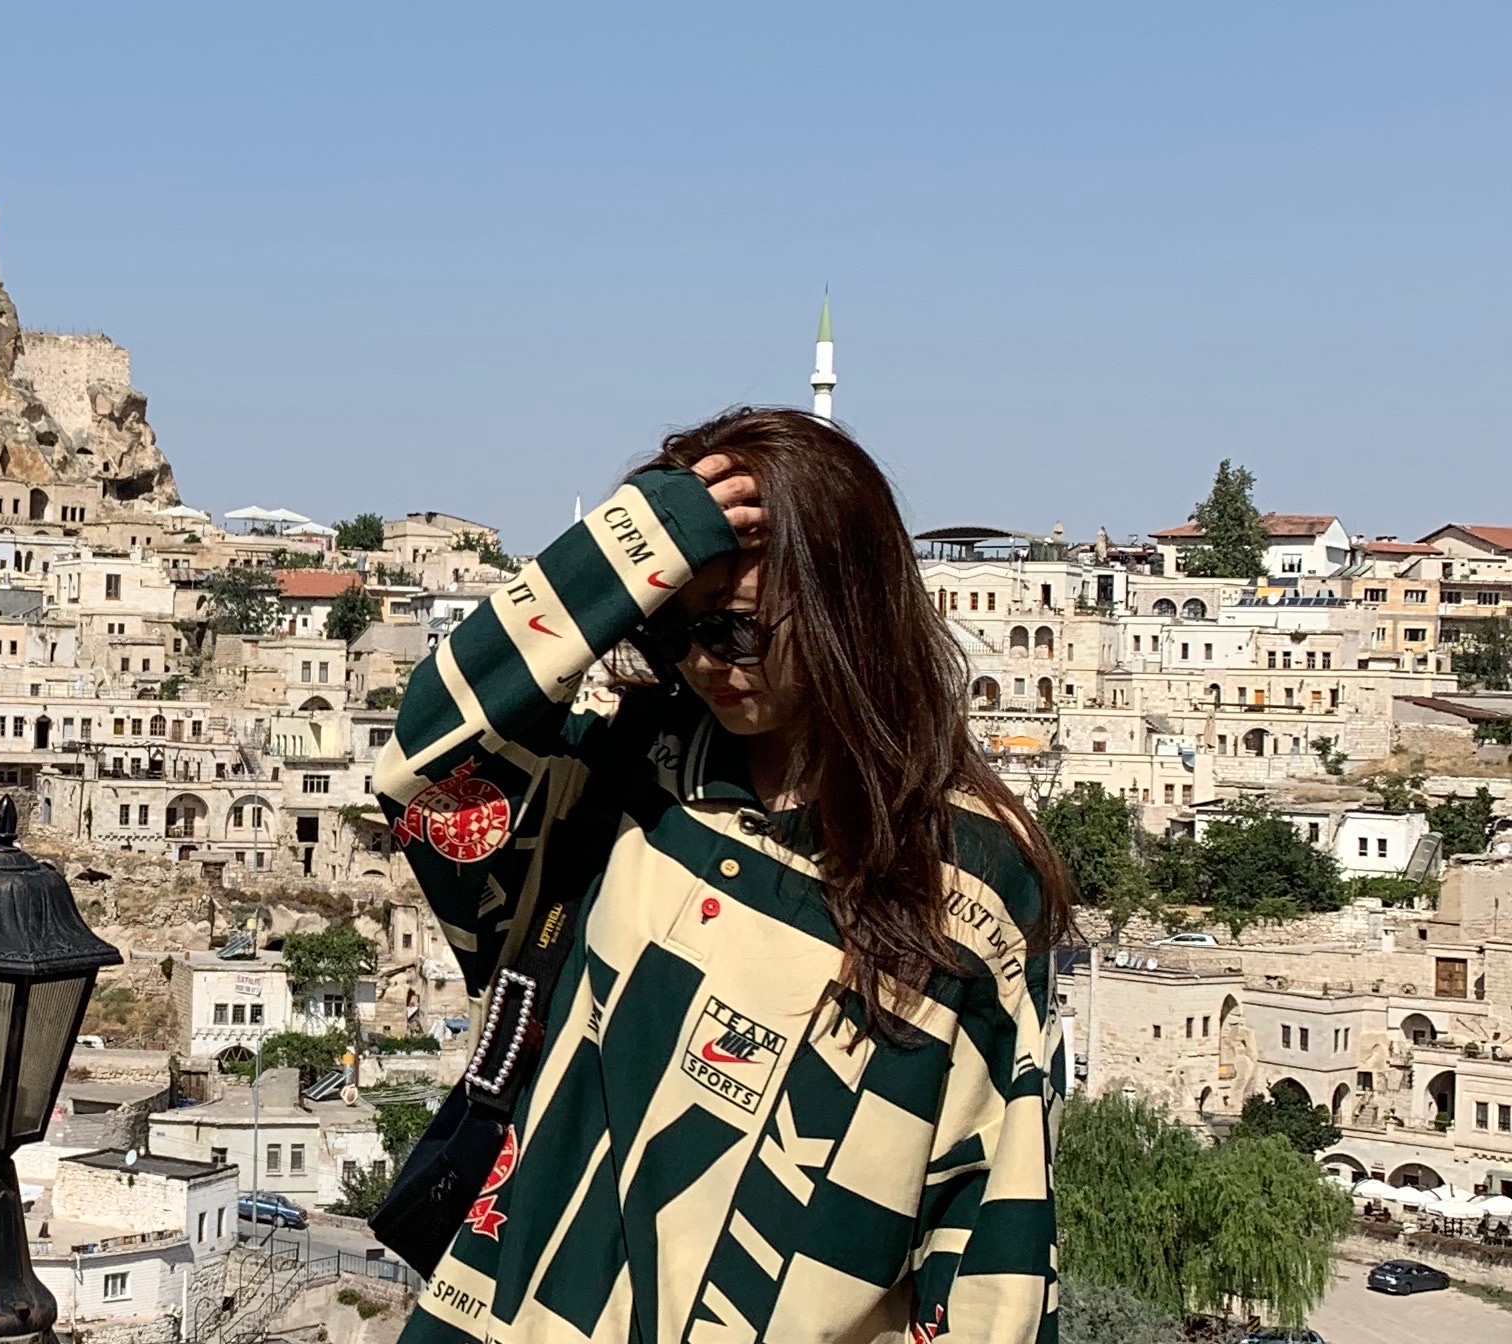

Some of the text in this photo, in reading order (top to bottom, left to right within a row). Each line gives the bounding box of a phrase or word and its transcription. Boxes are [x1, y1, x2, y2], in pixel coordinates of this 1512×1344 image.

[603, 506, 656, 566] CPFM
[507, 581, 537, 606] IT
[986, 923, 1008, 959] DO
[1000, 956, 1023, 984] IT
[714, 1001, 780, 1055] TEAM
[714, 1031, 760, 1060] NIKE
[688, 1058, 755, 1106] SPORTS
[433, 1280, 487, 1319] SPIRIT
